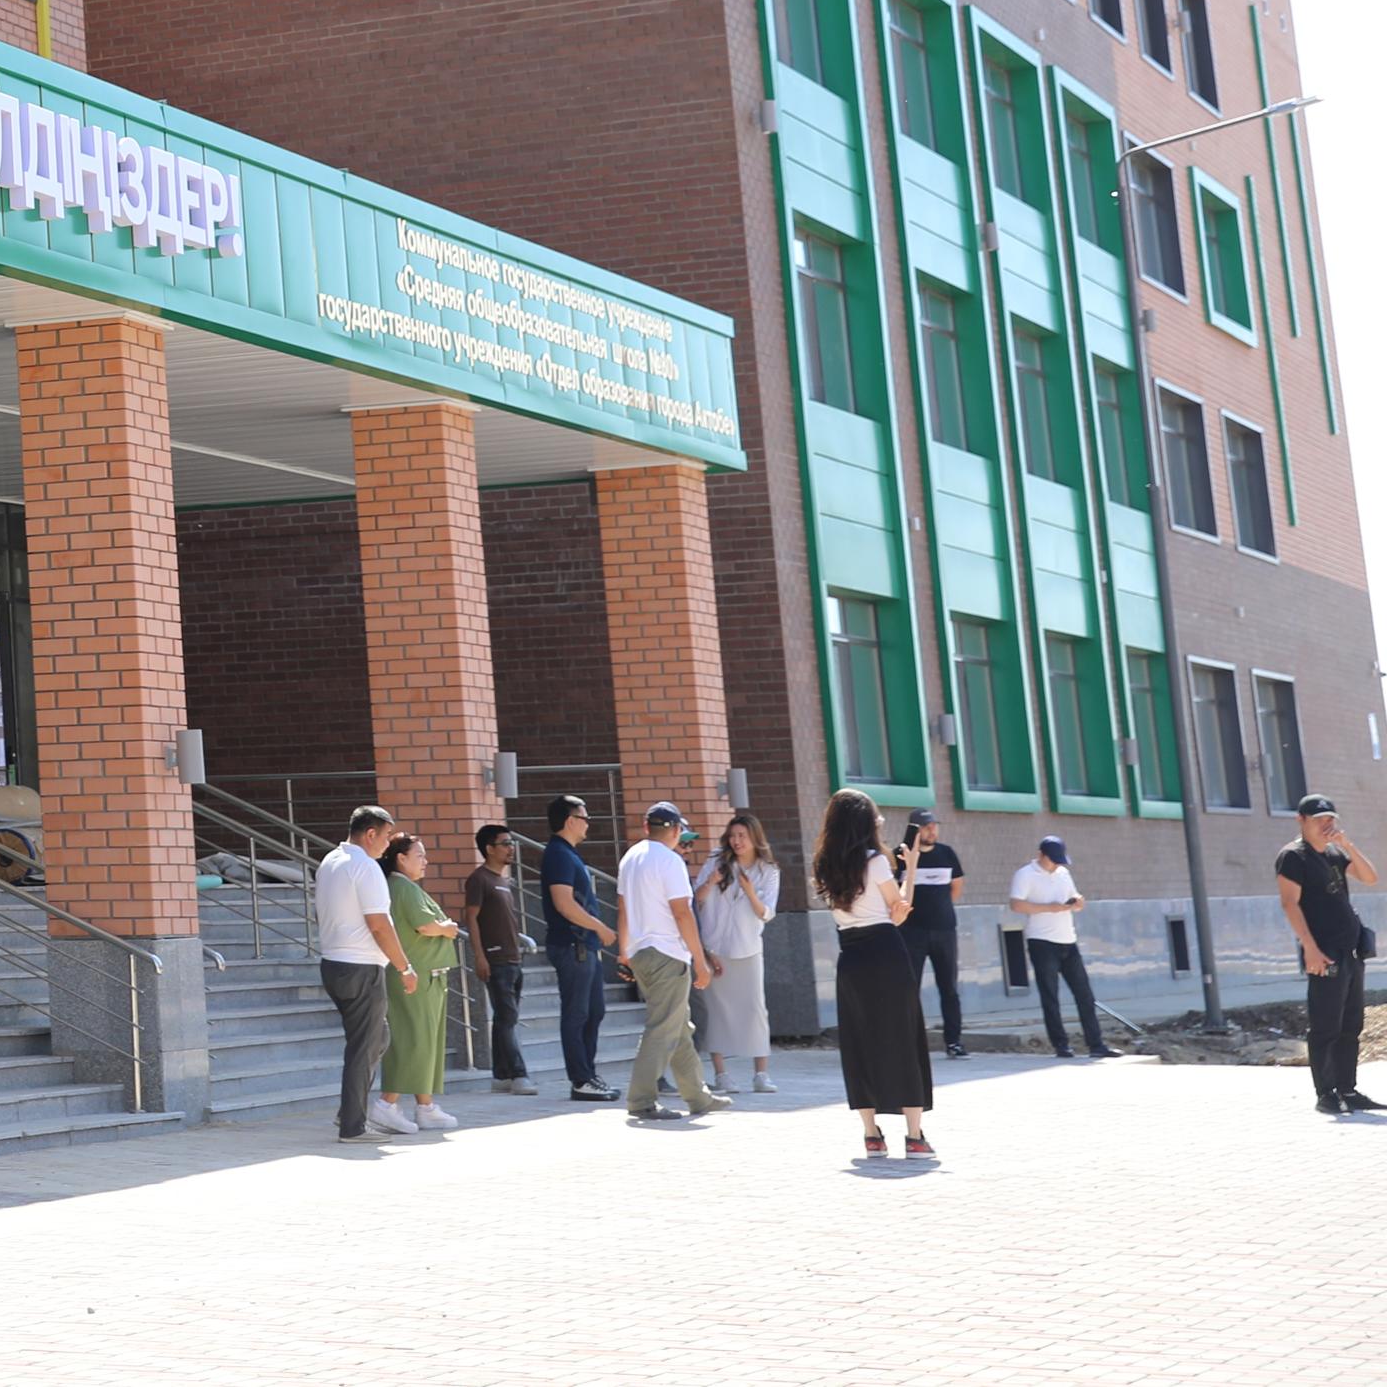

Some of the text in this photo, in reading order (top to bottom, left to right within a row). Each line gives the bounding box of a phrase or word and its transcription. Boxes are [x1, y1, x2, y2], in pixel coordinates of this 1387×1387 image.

[396, 264, 679, 381] «Средняя общеобразовательная школа №80»
[397, 218, 672, 342] Коммунальное государственное учреждение
[317, 293, 735, 437] государственного учреждения «Отдел образования города Актобе»
